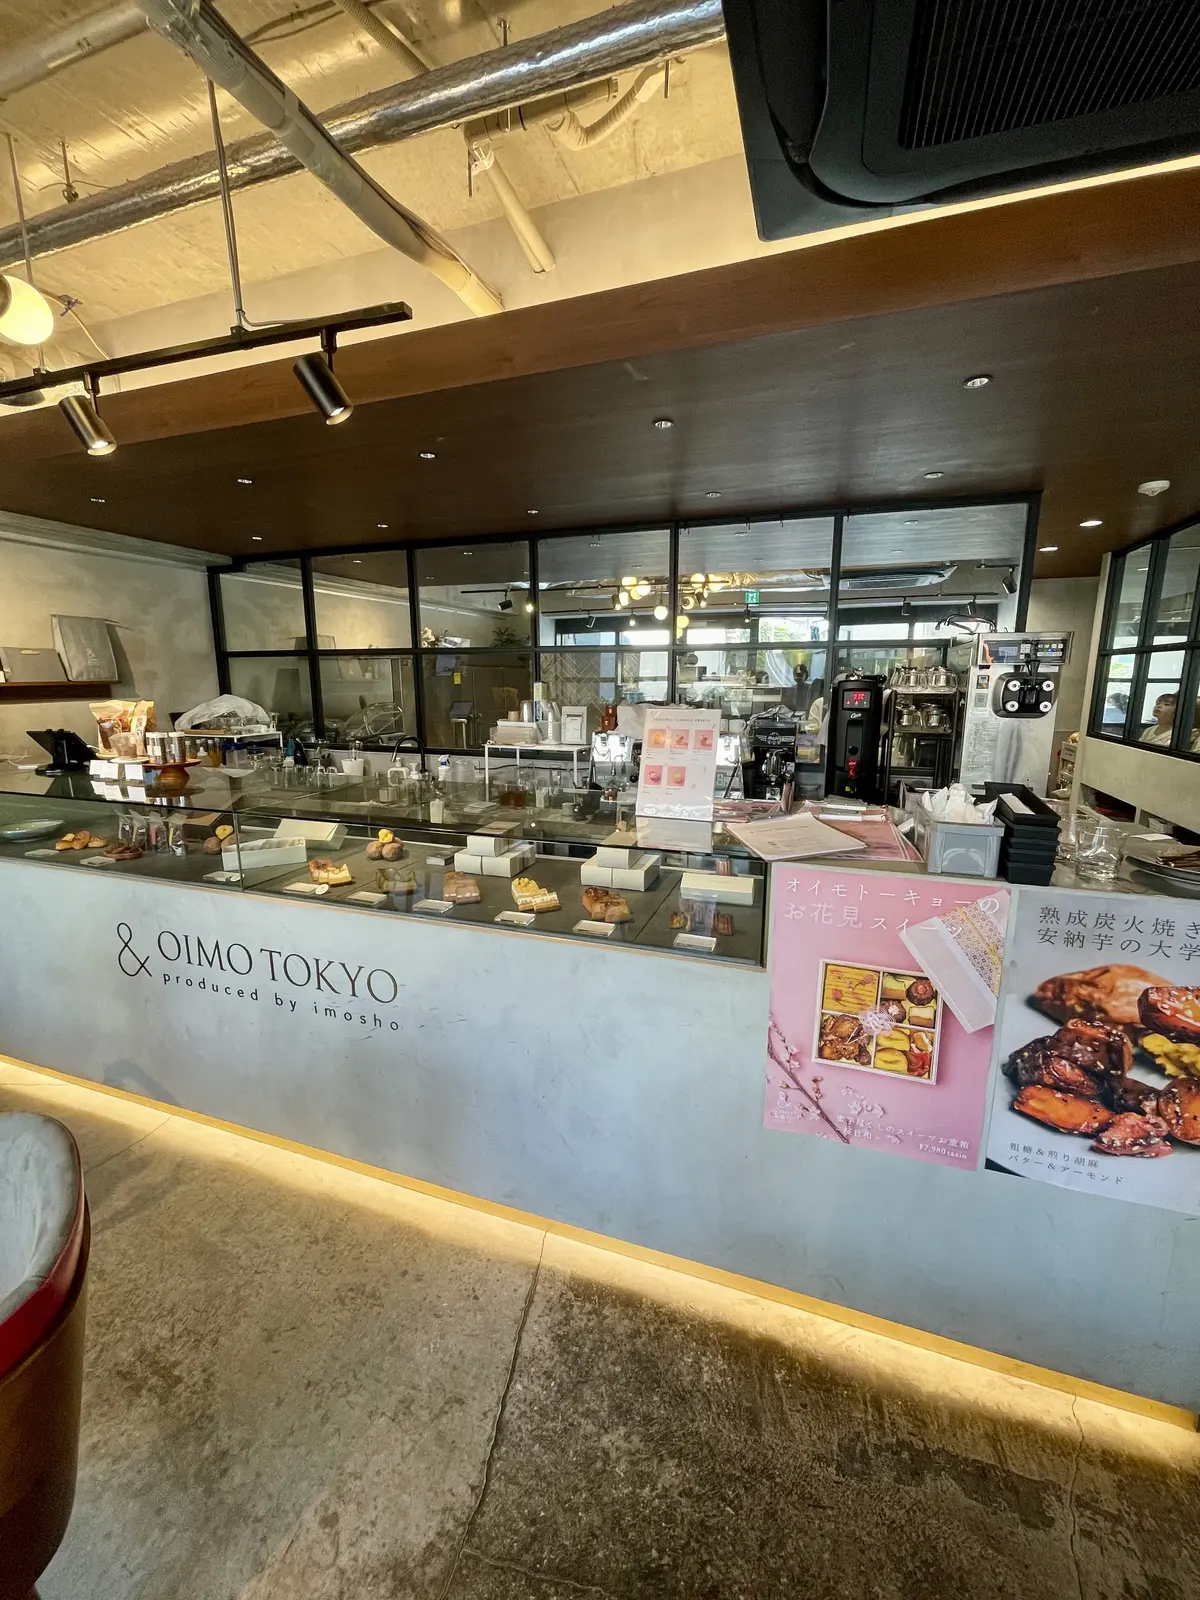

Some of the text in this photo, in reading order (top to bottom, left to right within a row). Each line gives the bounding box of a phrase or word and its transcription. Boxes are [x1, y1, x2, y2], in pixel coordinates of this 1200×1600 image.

[783, 877, 1000, 914] オイモトーキョーの
[783, 902, 964, 939] お花見スイーツ
[1038, 906, 1200, 939] 熟成炭火焼き
[1036, 927, 1200, 961] 安納芋の大学
[116, 922, 399, 1004] & OIMO TOKYO
[162, 971, 400, 1031] produced by imosho
